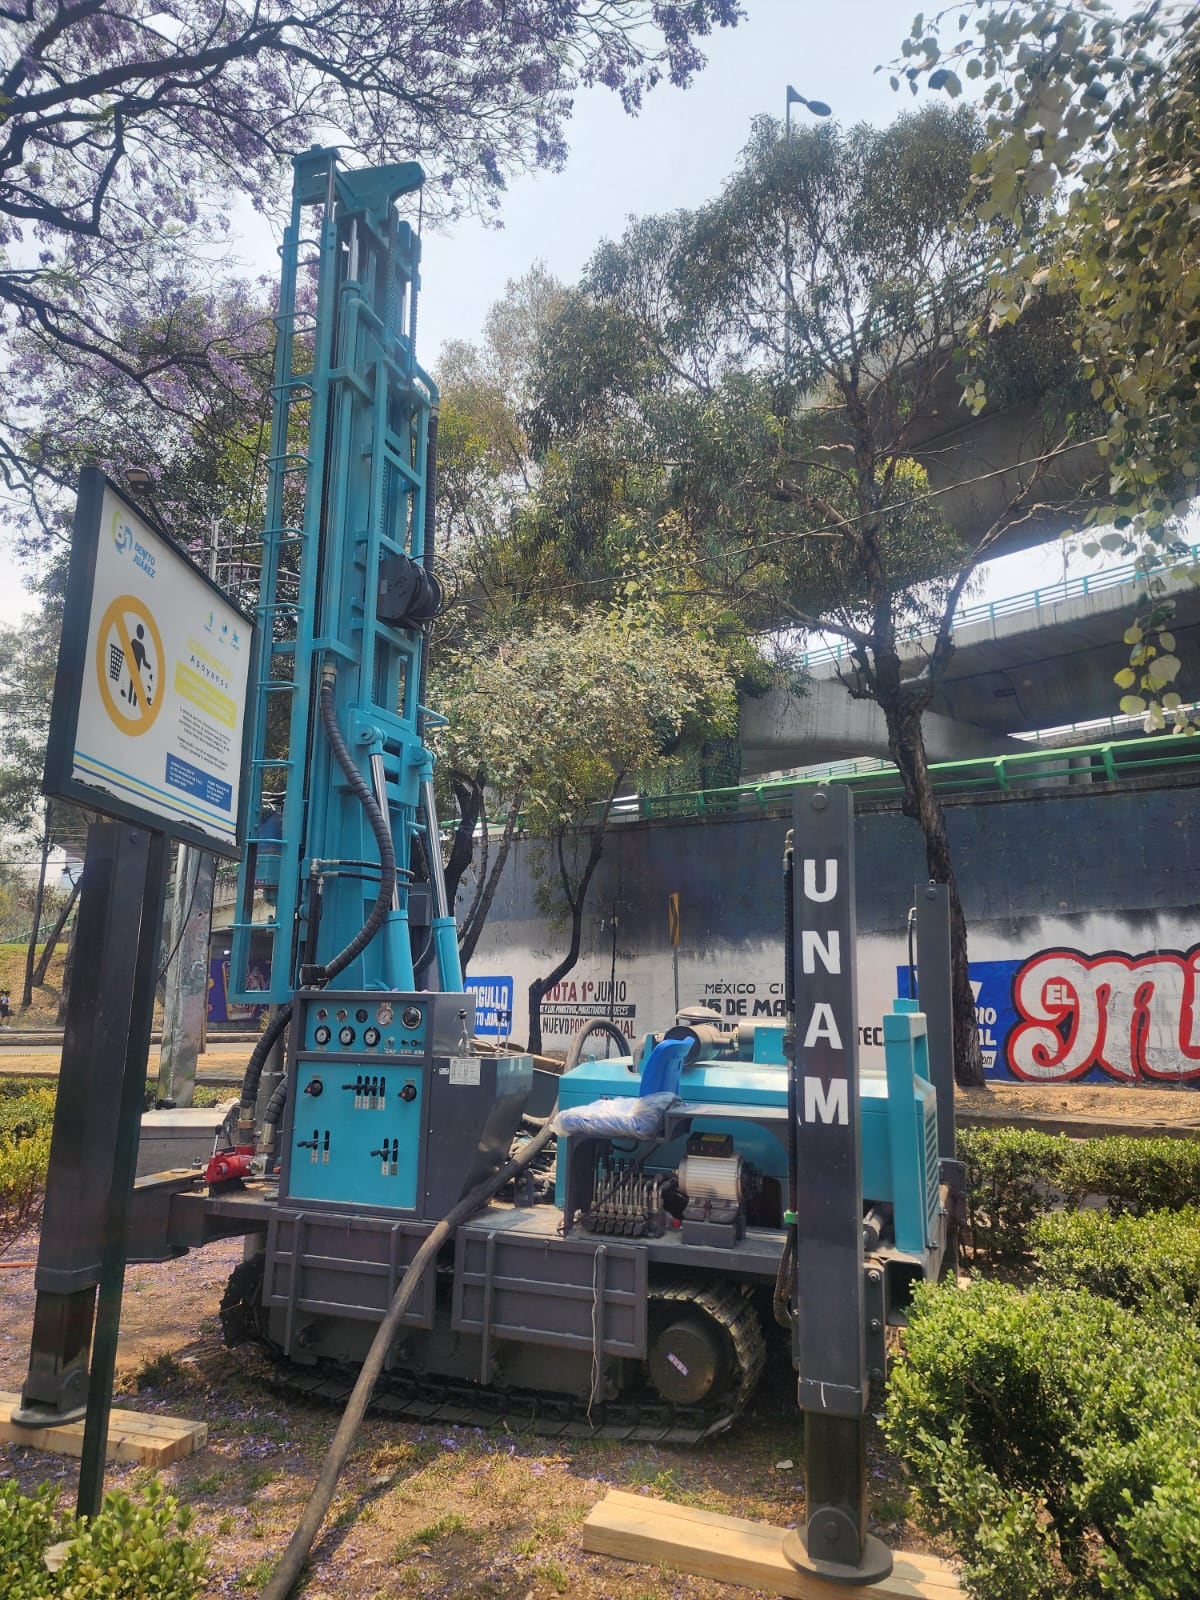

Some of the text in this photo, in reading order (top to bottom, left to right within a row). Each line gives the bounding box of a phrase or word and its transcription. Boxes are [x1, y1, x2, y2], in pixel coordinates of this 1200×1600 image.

[134, 542, 156, 566] BENITO
[132, 556, 156, 579] JUÁREZ
[545, 982, 578, 1002] VOTA
[594, 981, 627, 1002] JUNIO
[801, 859, 849, 1126] UNAM
[1046, 984, 1075, 1005] EL
[726, 999, 747, 1016] DE
[542, 1017, 570, 1035] NUEVO
